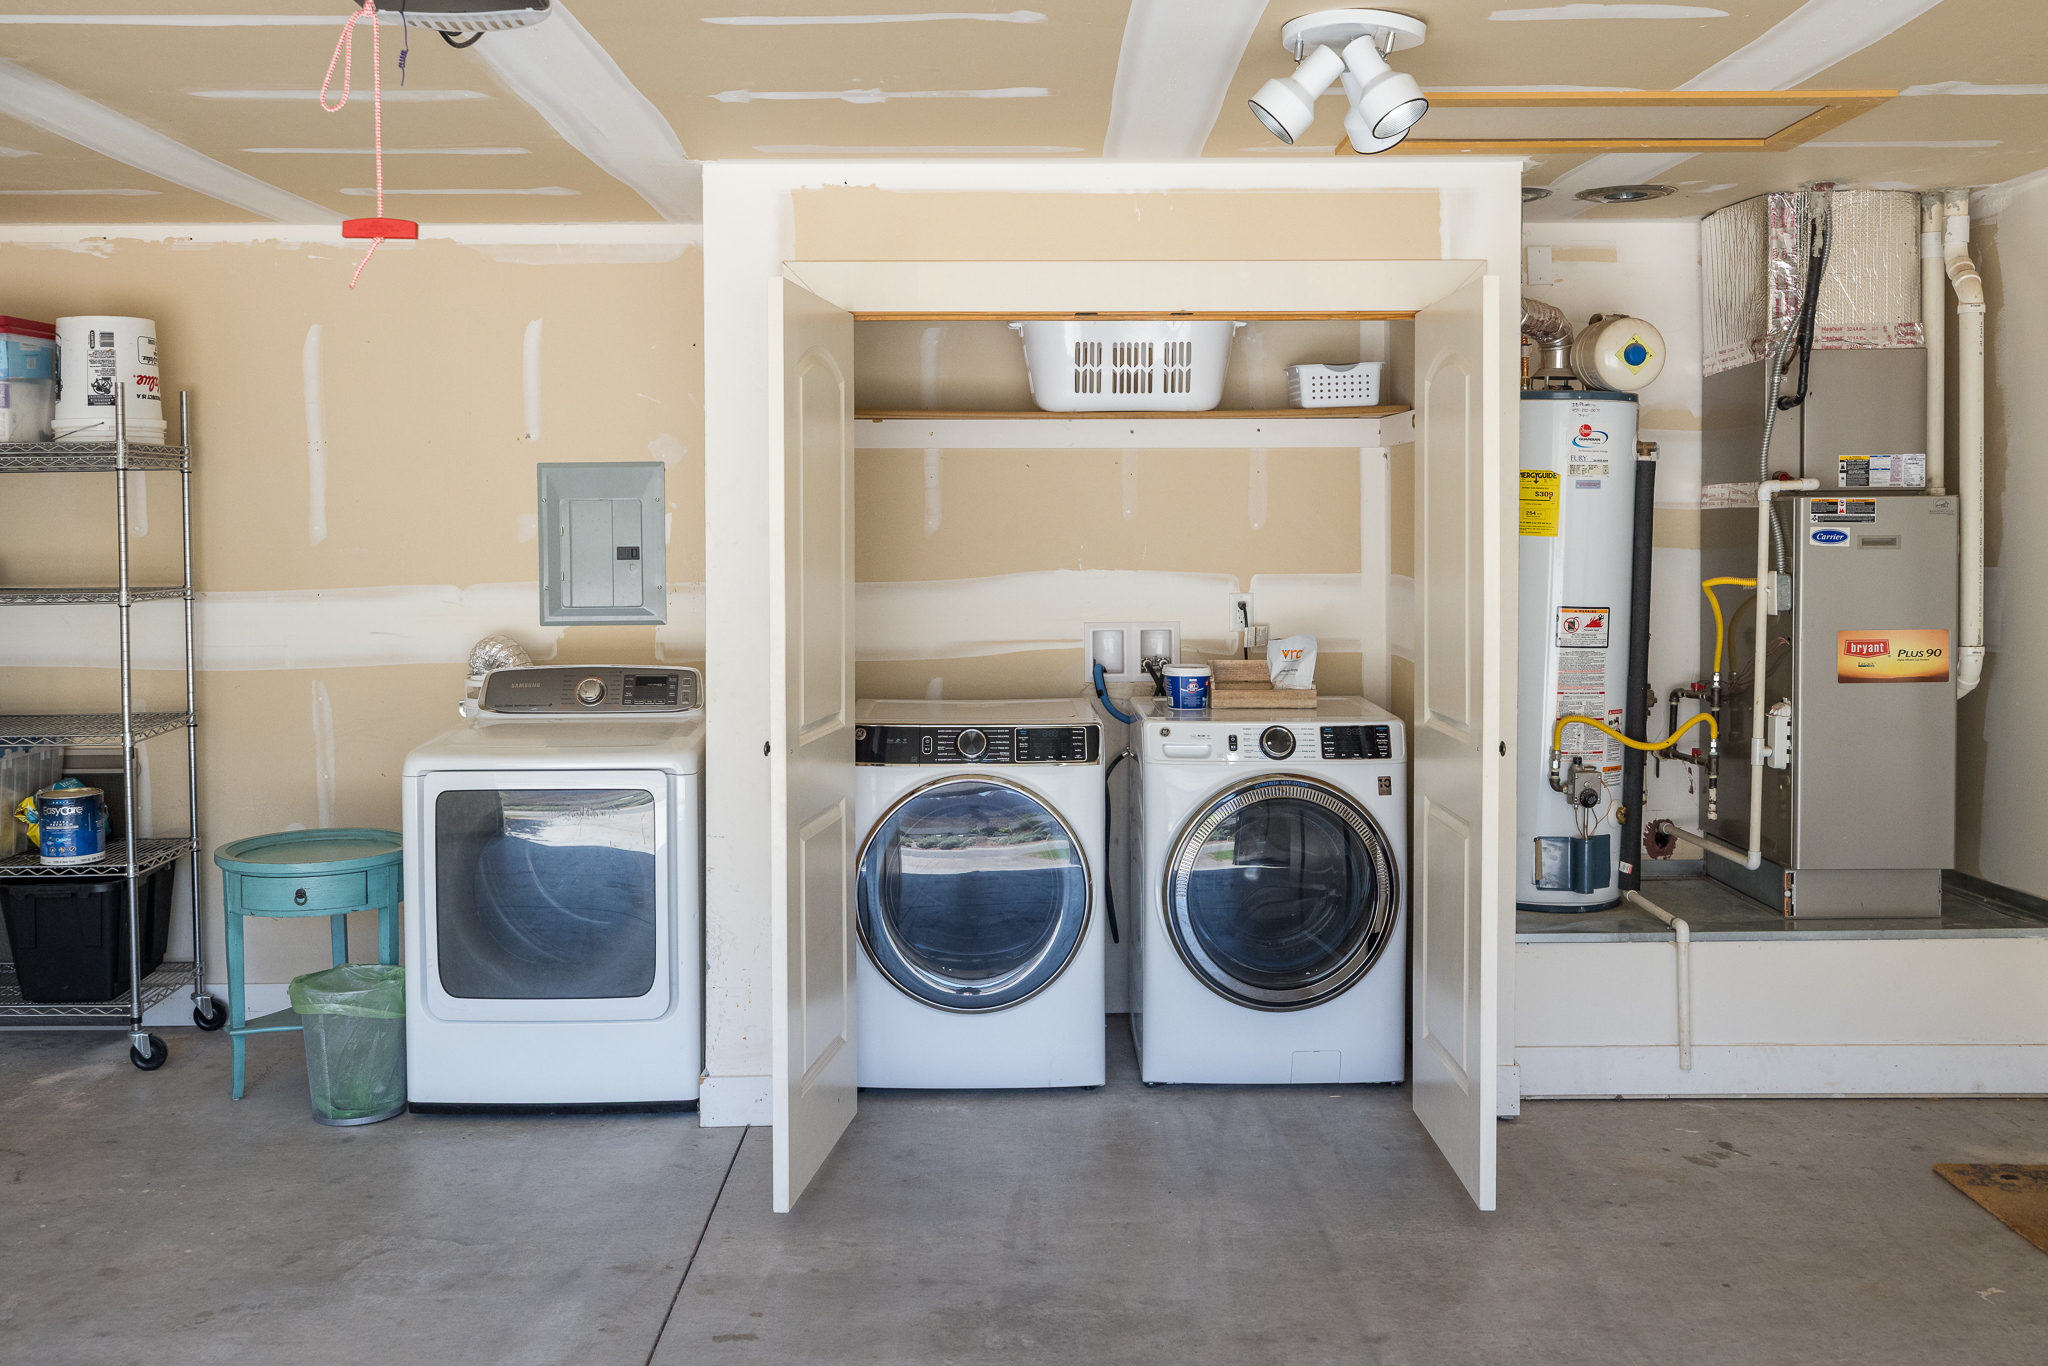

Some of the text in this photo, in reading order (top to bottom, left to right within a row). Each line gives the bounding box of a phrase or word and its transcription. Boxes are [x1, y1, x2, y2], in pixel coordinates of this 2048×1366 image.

[1816, 533, 1844, 541] Carrier
[1851, 643, 1884, 654] bryant
[1926, 649, 1942, 657] 90
[1281, 650, 1303, 659] vrc
[43, 806, 83, 816] EasyCare
